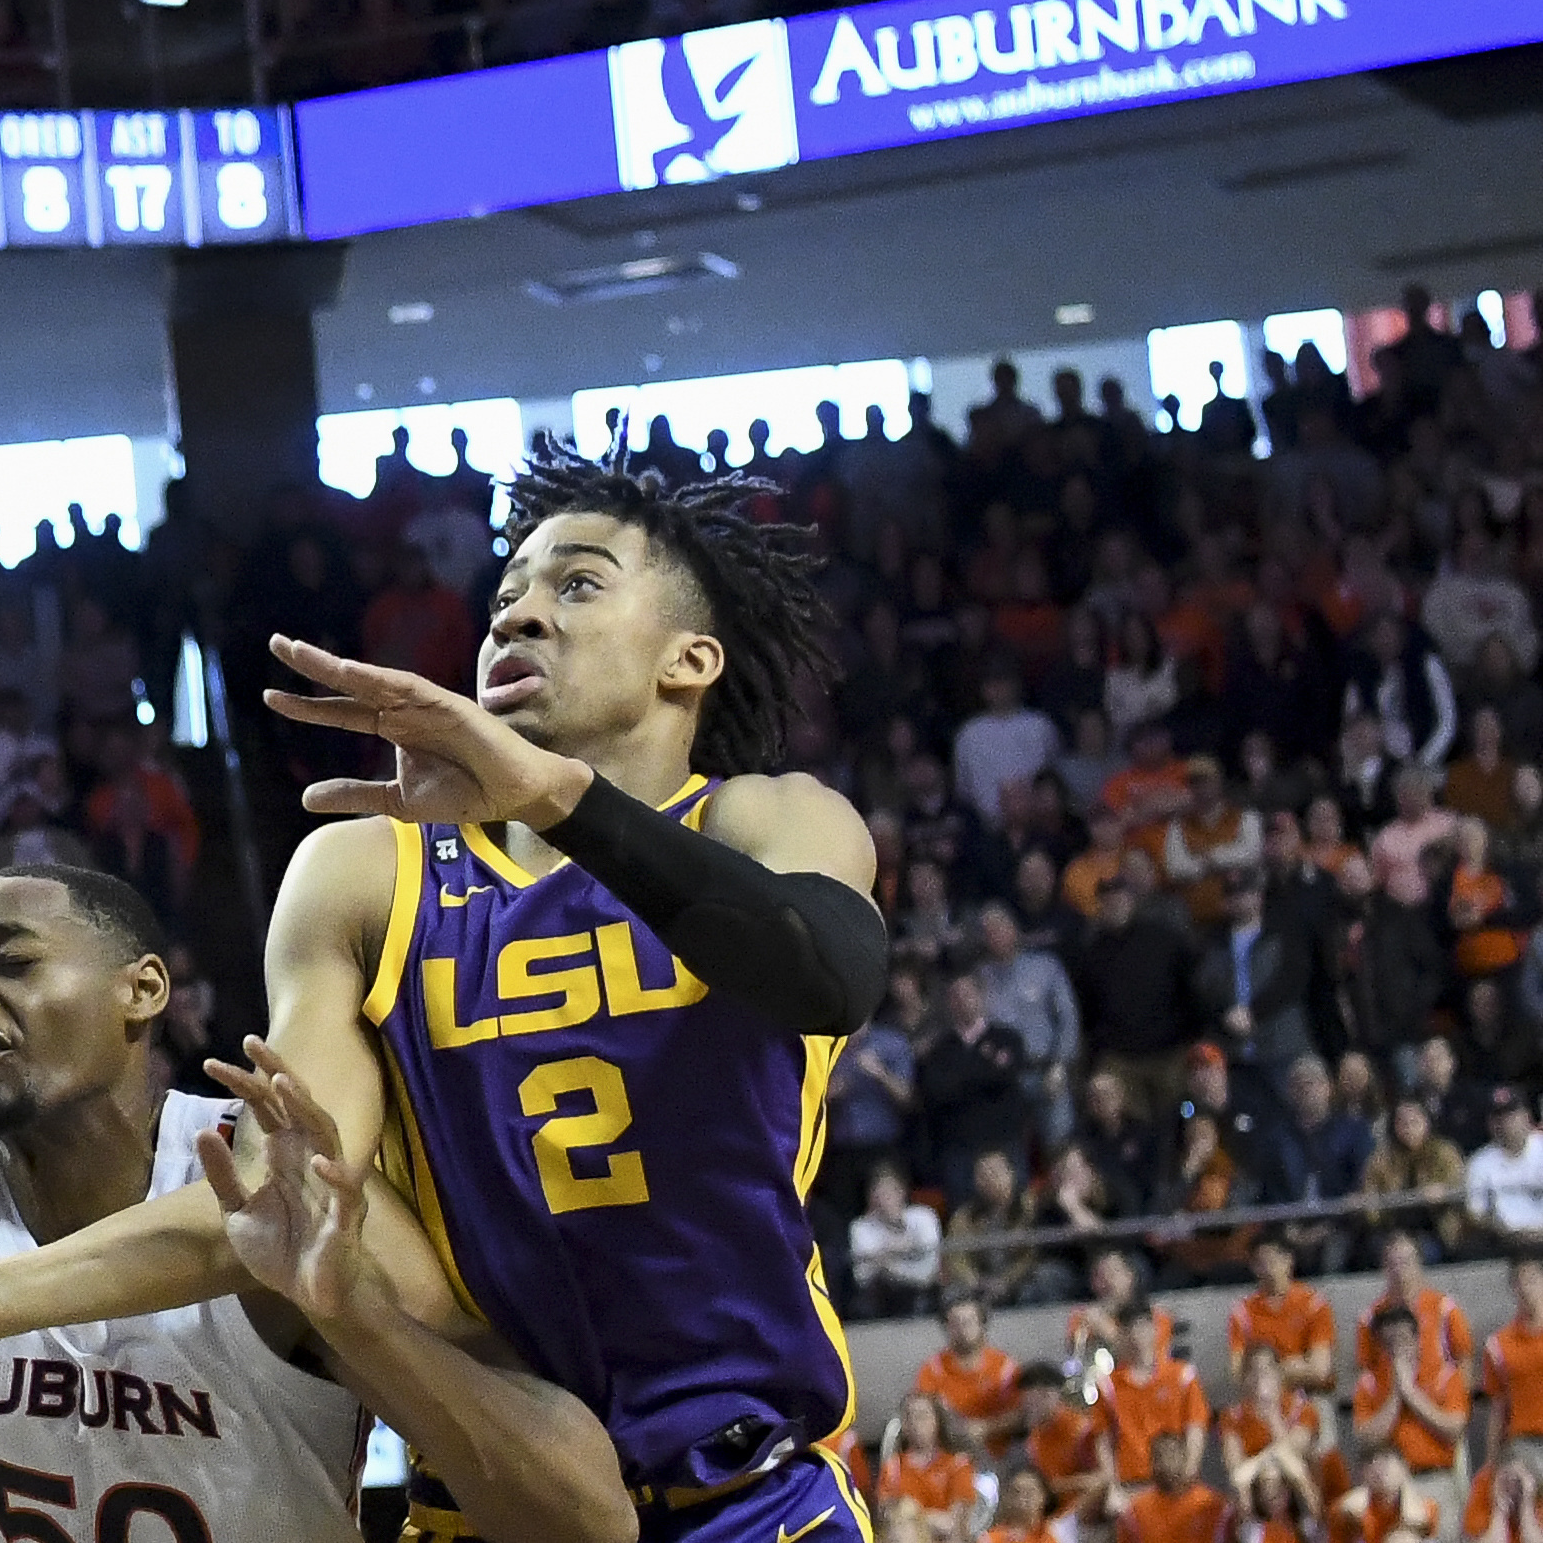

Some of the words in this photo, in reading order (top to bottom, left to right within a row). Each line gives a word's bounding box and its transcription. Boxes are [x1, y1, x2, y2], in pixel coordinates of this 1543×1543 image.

[109, 111, 168, 157] AST
[213, 109, 261, 156] TO
[105, 163, 173, 232] 17
[421, 920, 710, 1050] LSU
[517, 1055, 650, 1215] 2
